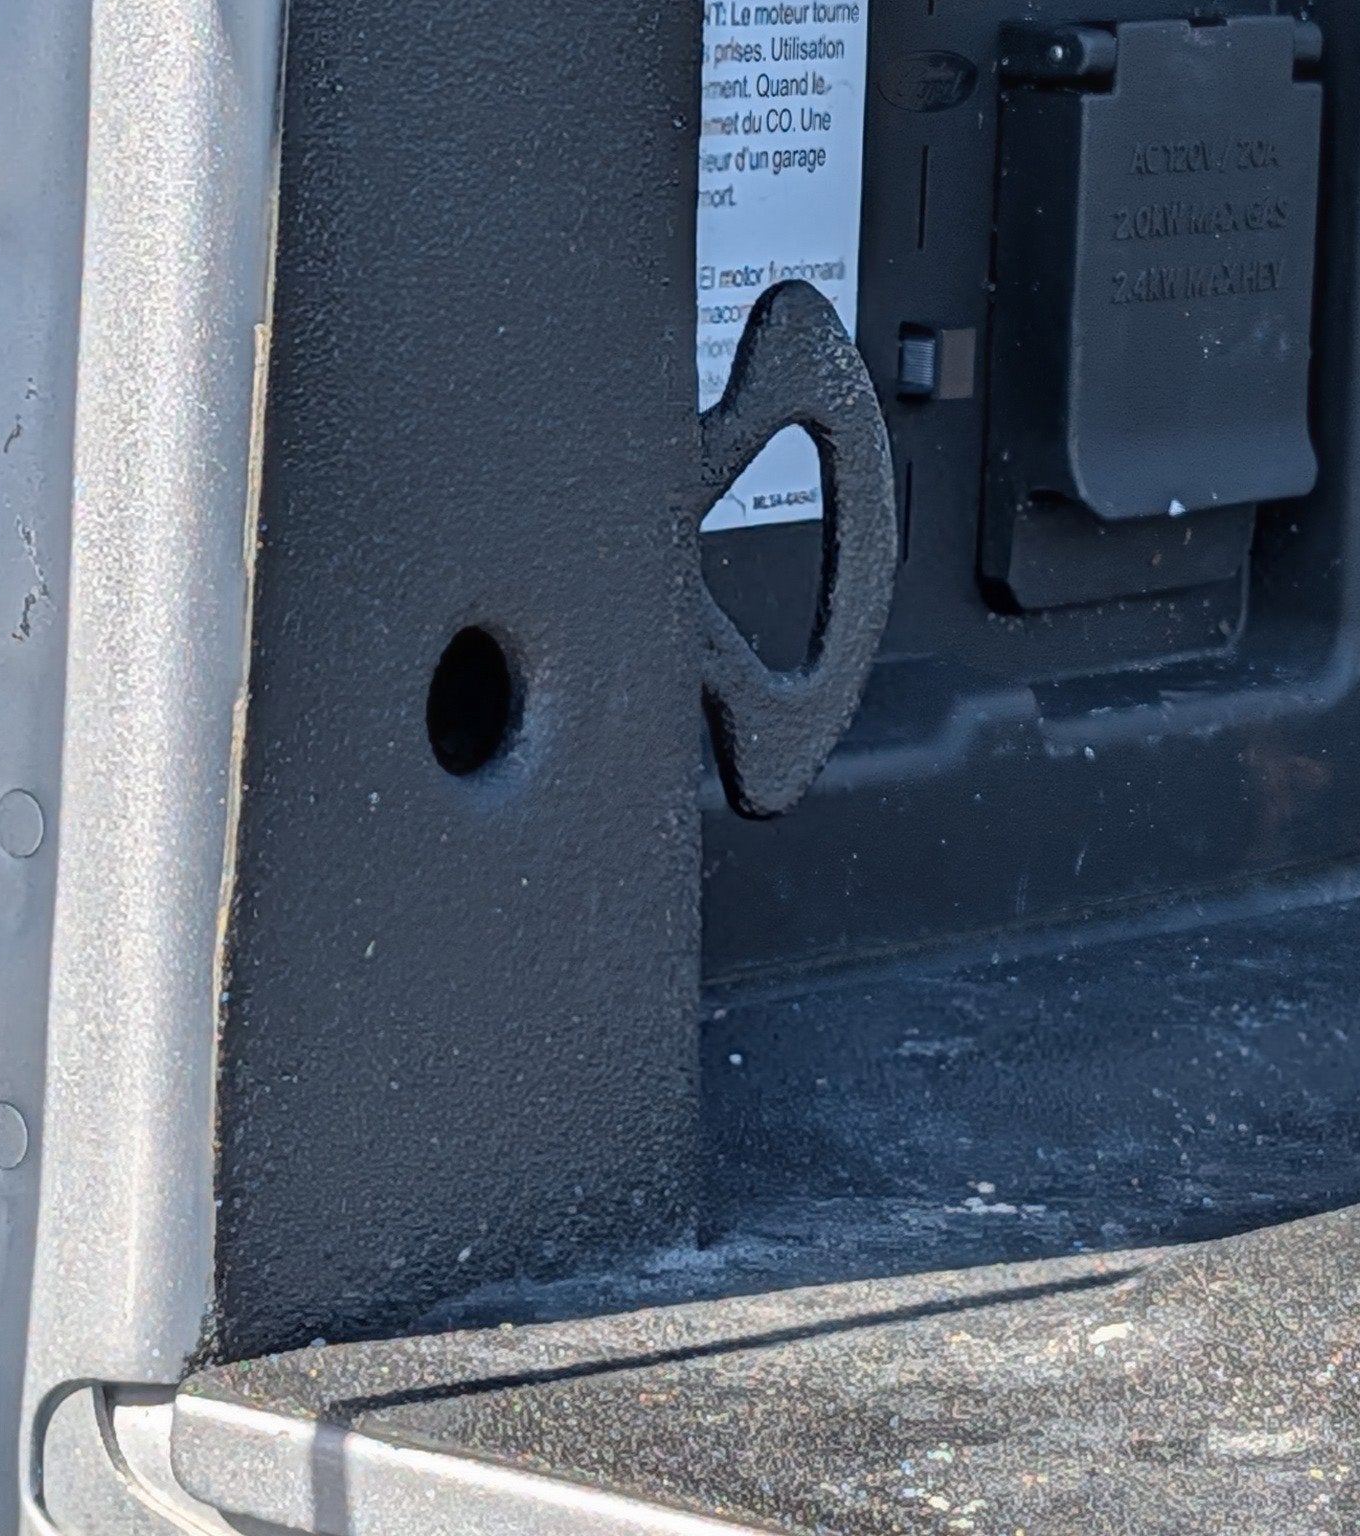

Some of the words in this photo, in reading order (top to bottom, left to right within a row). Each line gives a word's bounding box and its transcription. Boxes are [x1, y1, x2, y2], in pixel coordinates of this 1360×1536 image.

[730, 1, 751, 26] Le
[754, 1, 810, 26] moteur
[813, 0, 860, 24] tourne
[714, 37, 767, 68] prises.
[771, 34, 845, 62] Utilisation
[756, 71, 808, 98] Quand
[742, 109, 762, 135] du
[766, 108, 796, 133] CO.
[800, 107, 832, 131] Une
[734, 146, 769, 172] d'un
[772, 148, 827, 175] garage
[719, 265, 764, 288] motor
